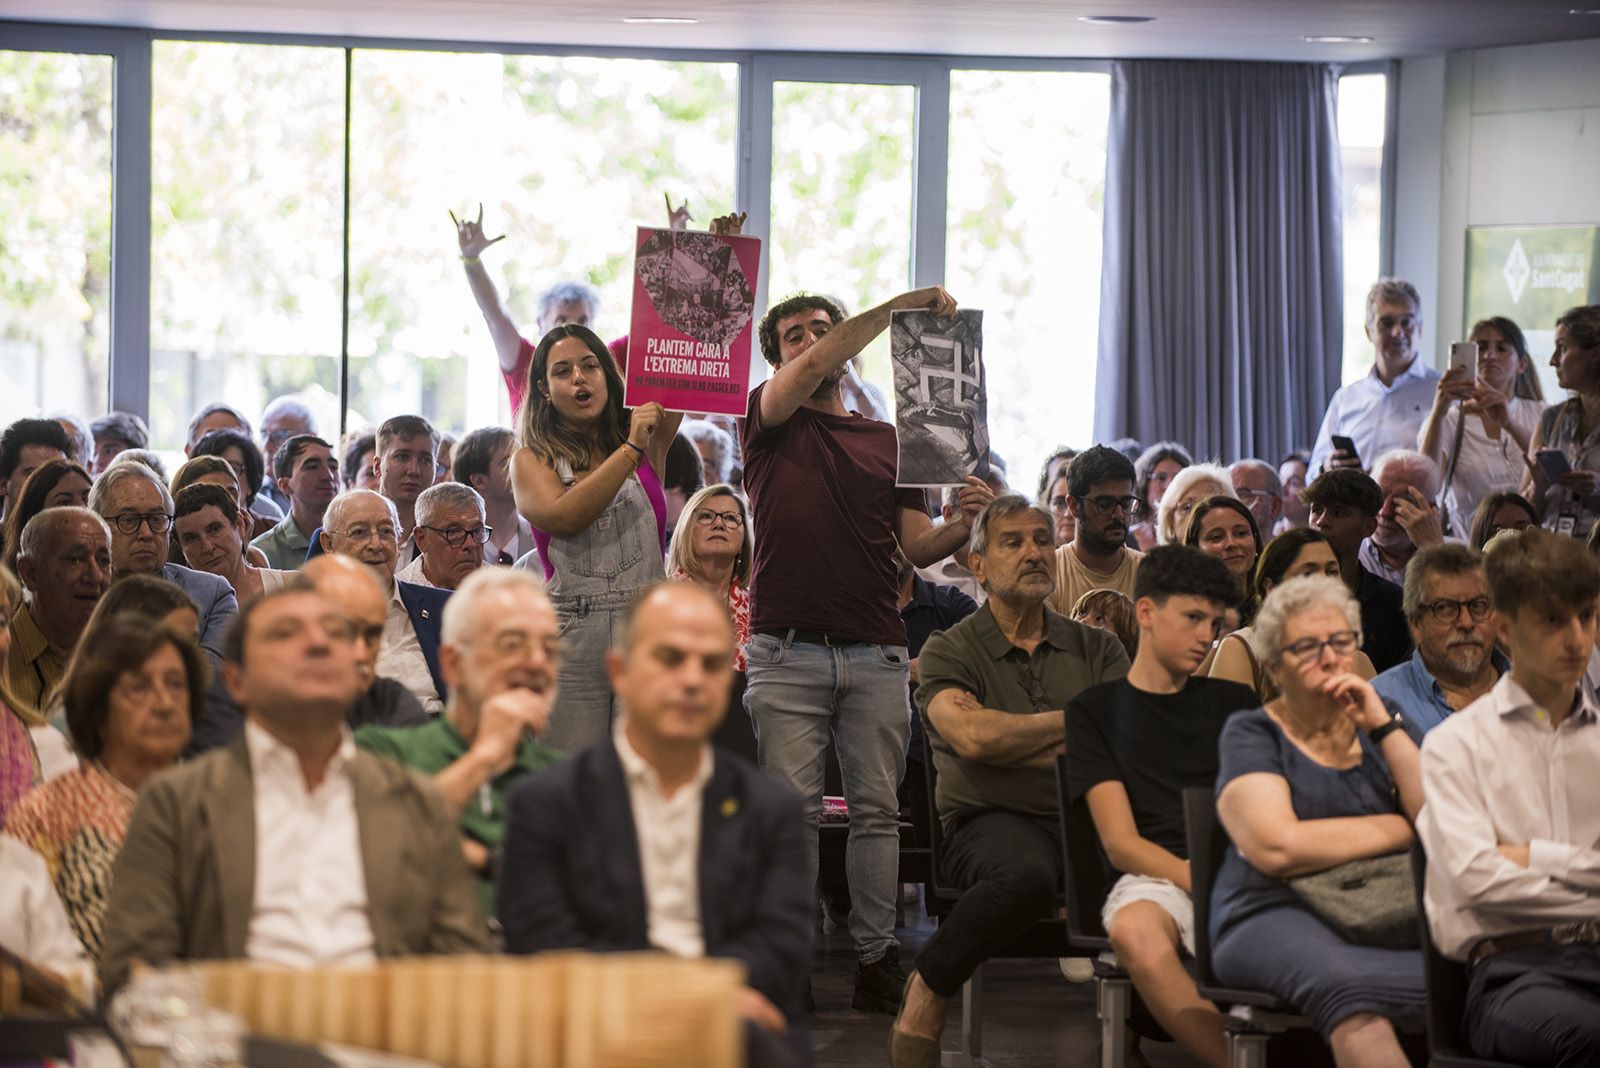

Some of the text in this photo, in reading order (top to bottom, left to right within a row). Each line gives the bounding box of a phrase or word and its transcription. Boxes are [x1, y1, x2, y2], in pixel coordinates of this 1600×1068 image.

[647, 338, 730, 360] PLANTEM CARA A
[644, 356, 730, 378] L'EXTREMA DRETA
